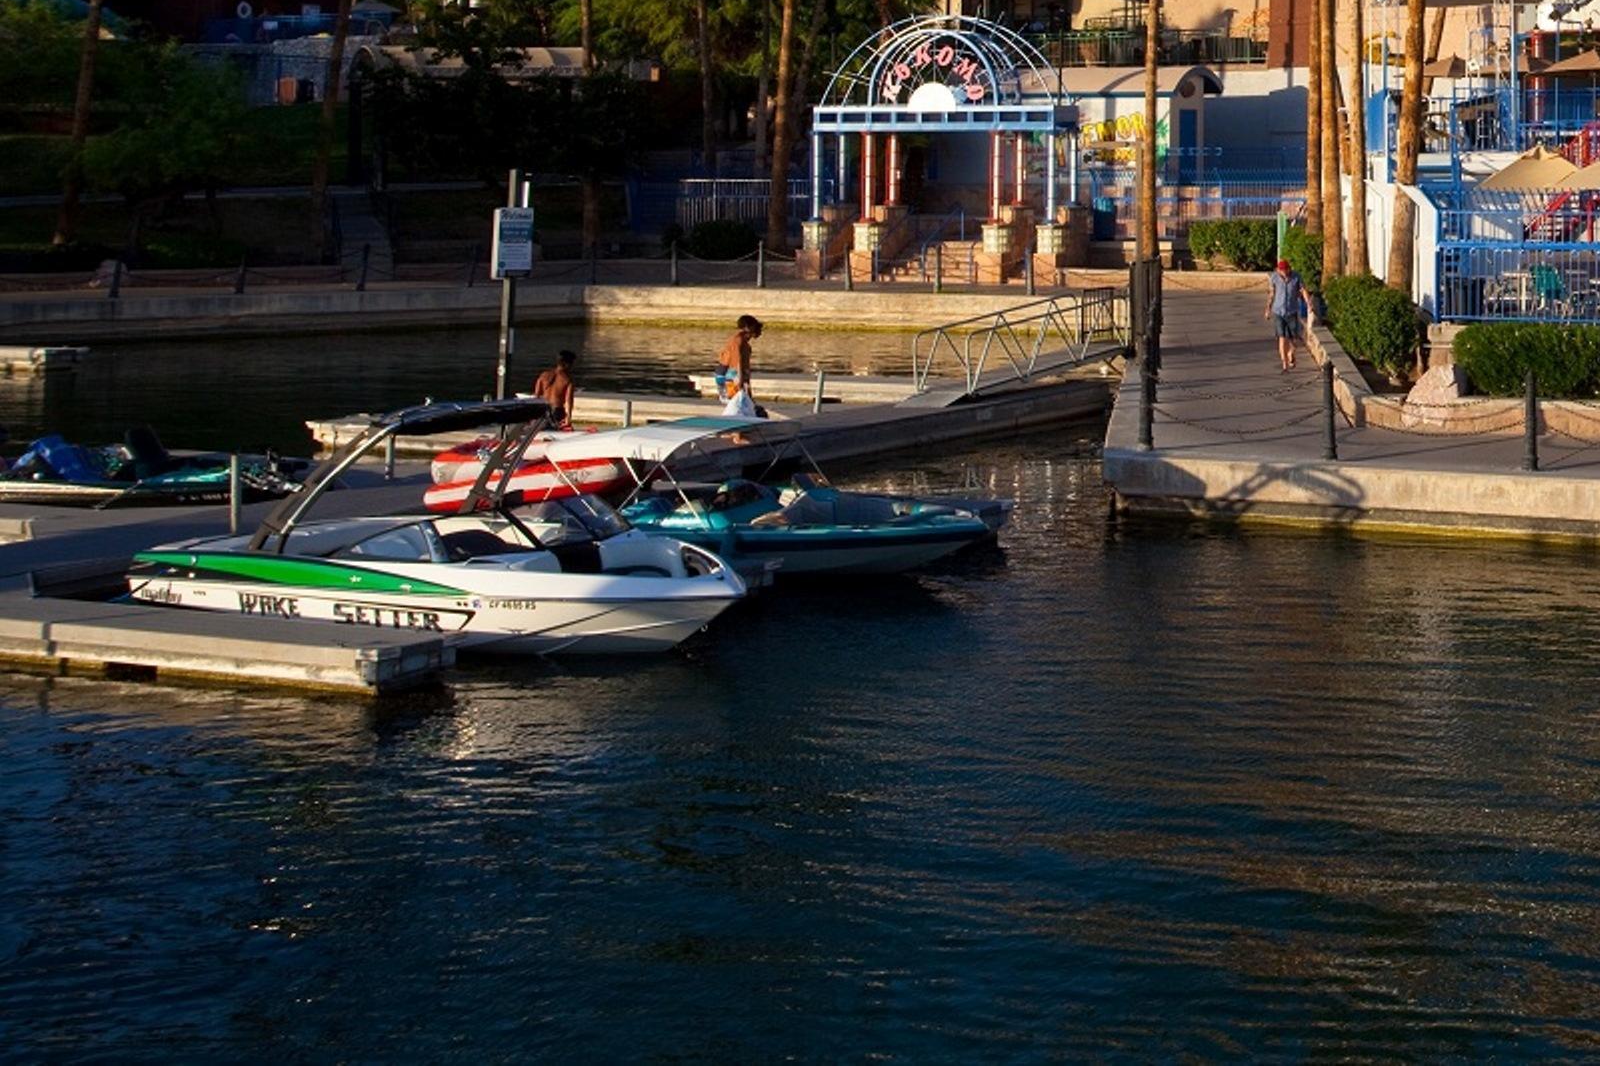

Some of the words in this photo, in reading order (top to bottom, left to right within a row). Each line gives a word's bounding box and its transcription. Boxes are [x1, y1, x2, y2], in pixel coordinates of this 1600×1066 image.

[882, 43, 984, 102] KOKOMO
[238, 592, 301, 619] WAKE
[333, 603, 443, 632] SETTER
